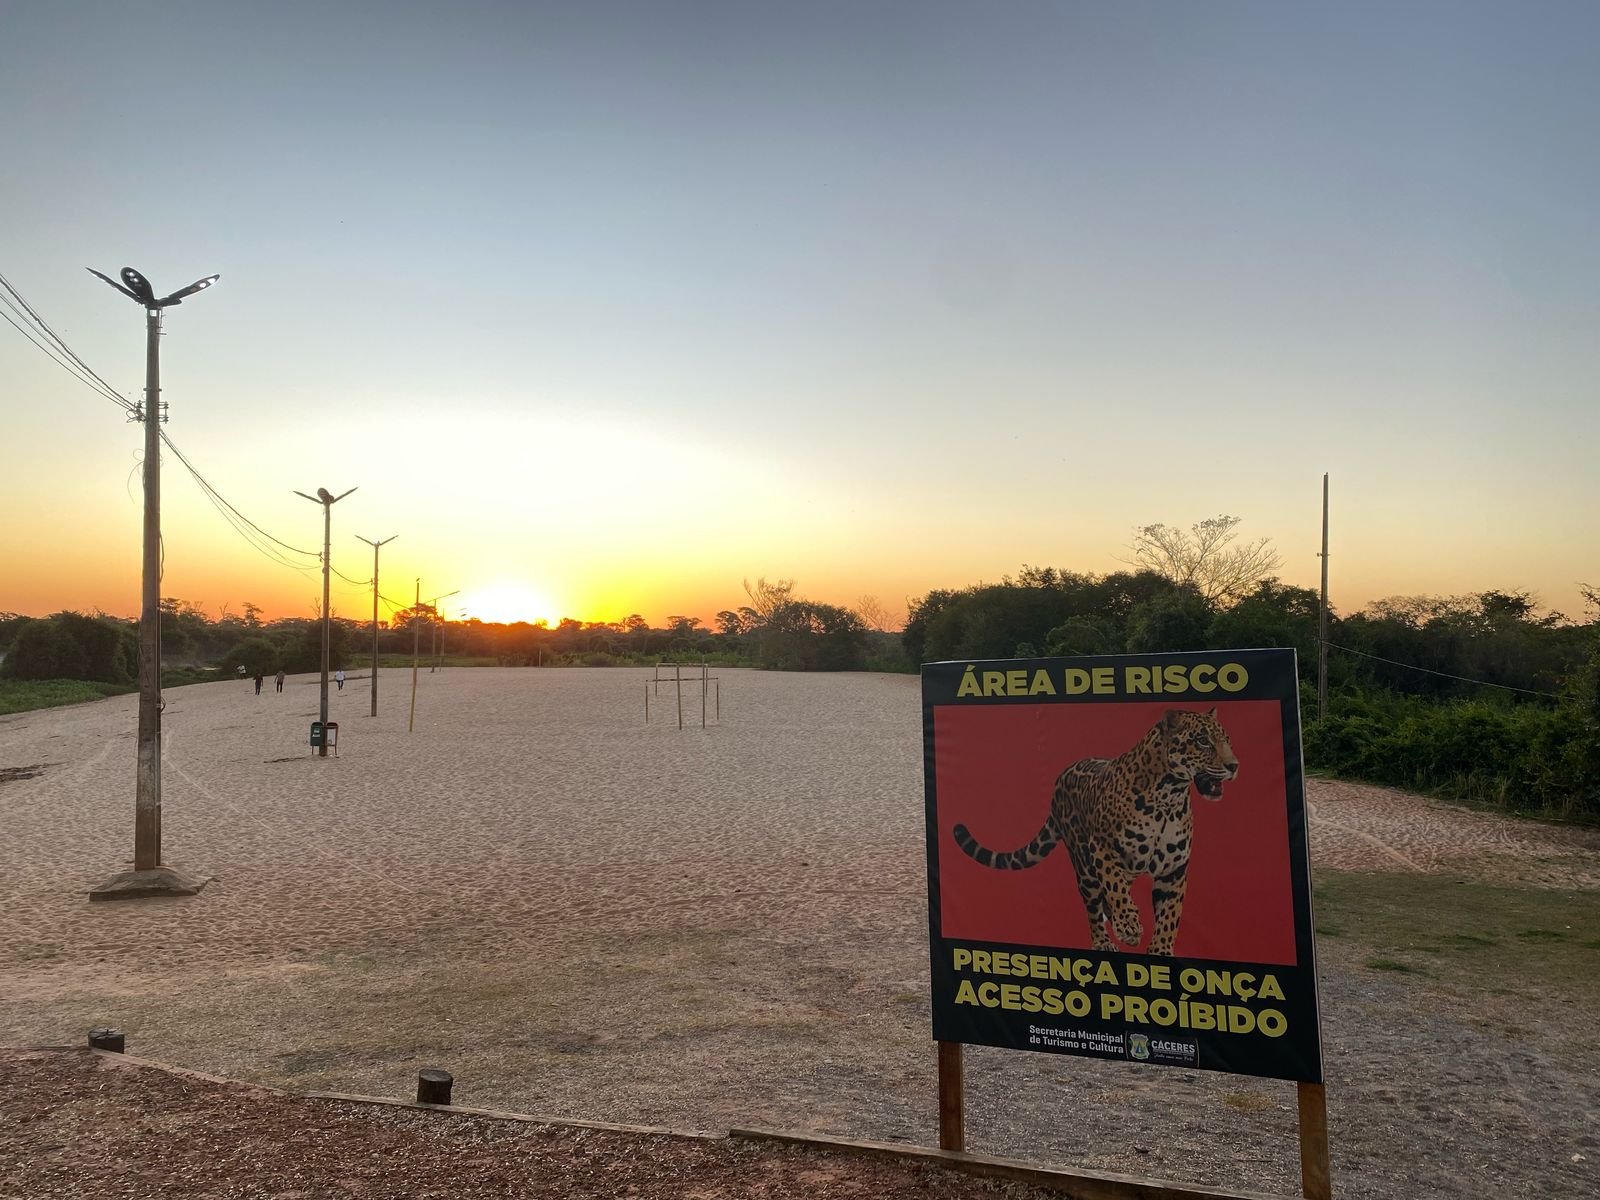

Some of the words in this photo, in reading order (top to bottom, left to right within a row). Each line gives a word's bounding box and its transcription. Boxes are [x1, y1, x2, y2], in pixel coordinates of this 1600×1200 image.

[957, 665, 1055, 697] ÁREA
[1065, 668, 1115, 695] DE
[1126, 663, 1248, 694] RISCO
[953, 948, 1119, 987] PRESENÇA
[1126, 963, 1171, 990] DE
[1179, 968, 1286, 1002] ONÇA
[954, 979, 1091, 1018] ACESSO
[1100, 992, 1288, 1037] PROÍBIDO
[1029, 1025, 1077, 1038] Secretaria
[1078, 1030, 1123, 1044] Municipal
[1029, 1035, 1041, 1044] de
[1043, 1036, 1079, 1049] Turismo
[1089, 1041, 1124, 1054] Cultura
